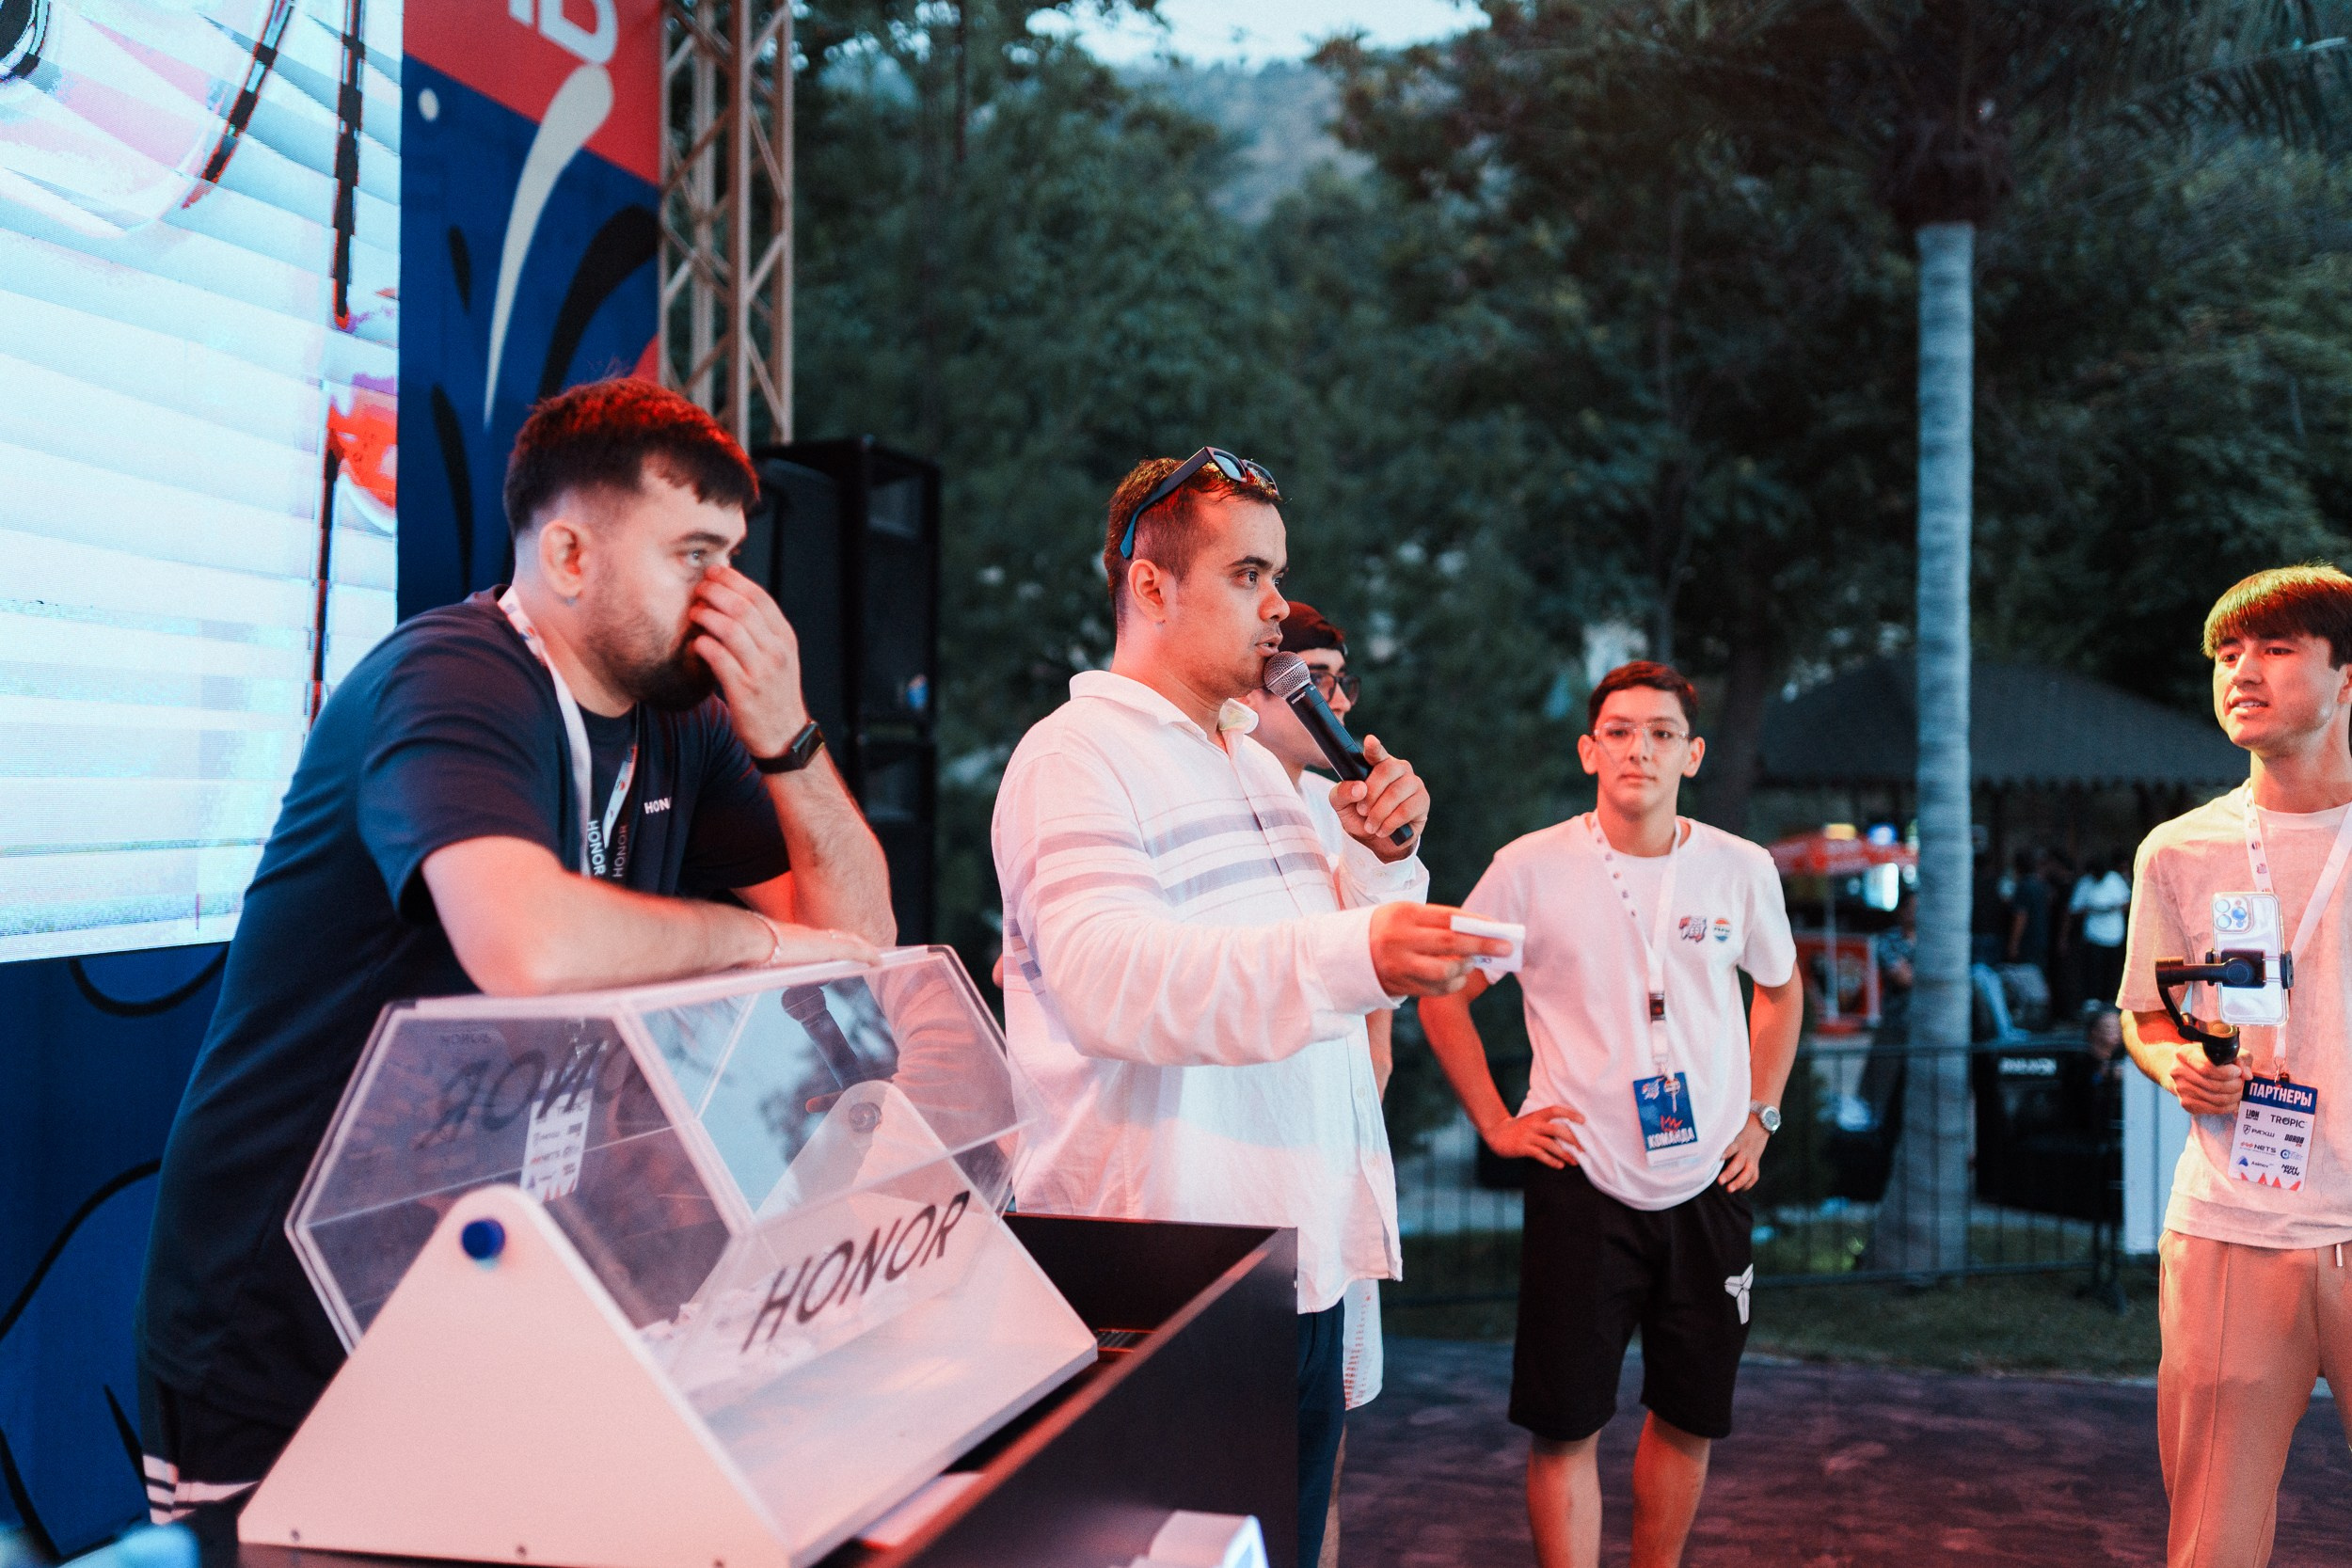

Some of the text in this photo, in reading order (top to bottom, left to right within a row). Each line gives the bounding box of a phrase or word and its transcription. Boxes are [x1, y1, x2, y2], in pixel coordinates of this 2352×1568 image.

[644, 797, 673, 815] HON
[587, 819, 607, 876] HONOR
[2249, 1082, 2312, 1107] ПАРТНЕРЫ
[2270, 1114, 2305, 1129] TROPIC
[1646, 1127, 1695, 1148] КОМАНДА
[741, 1190, 971, 1354] HONOR
